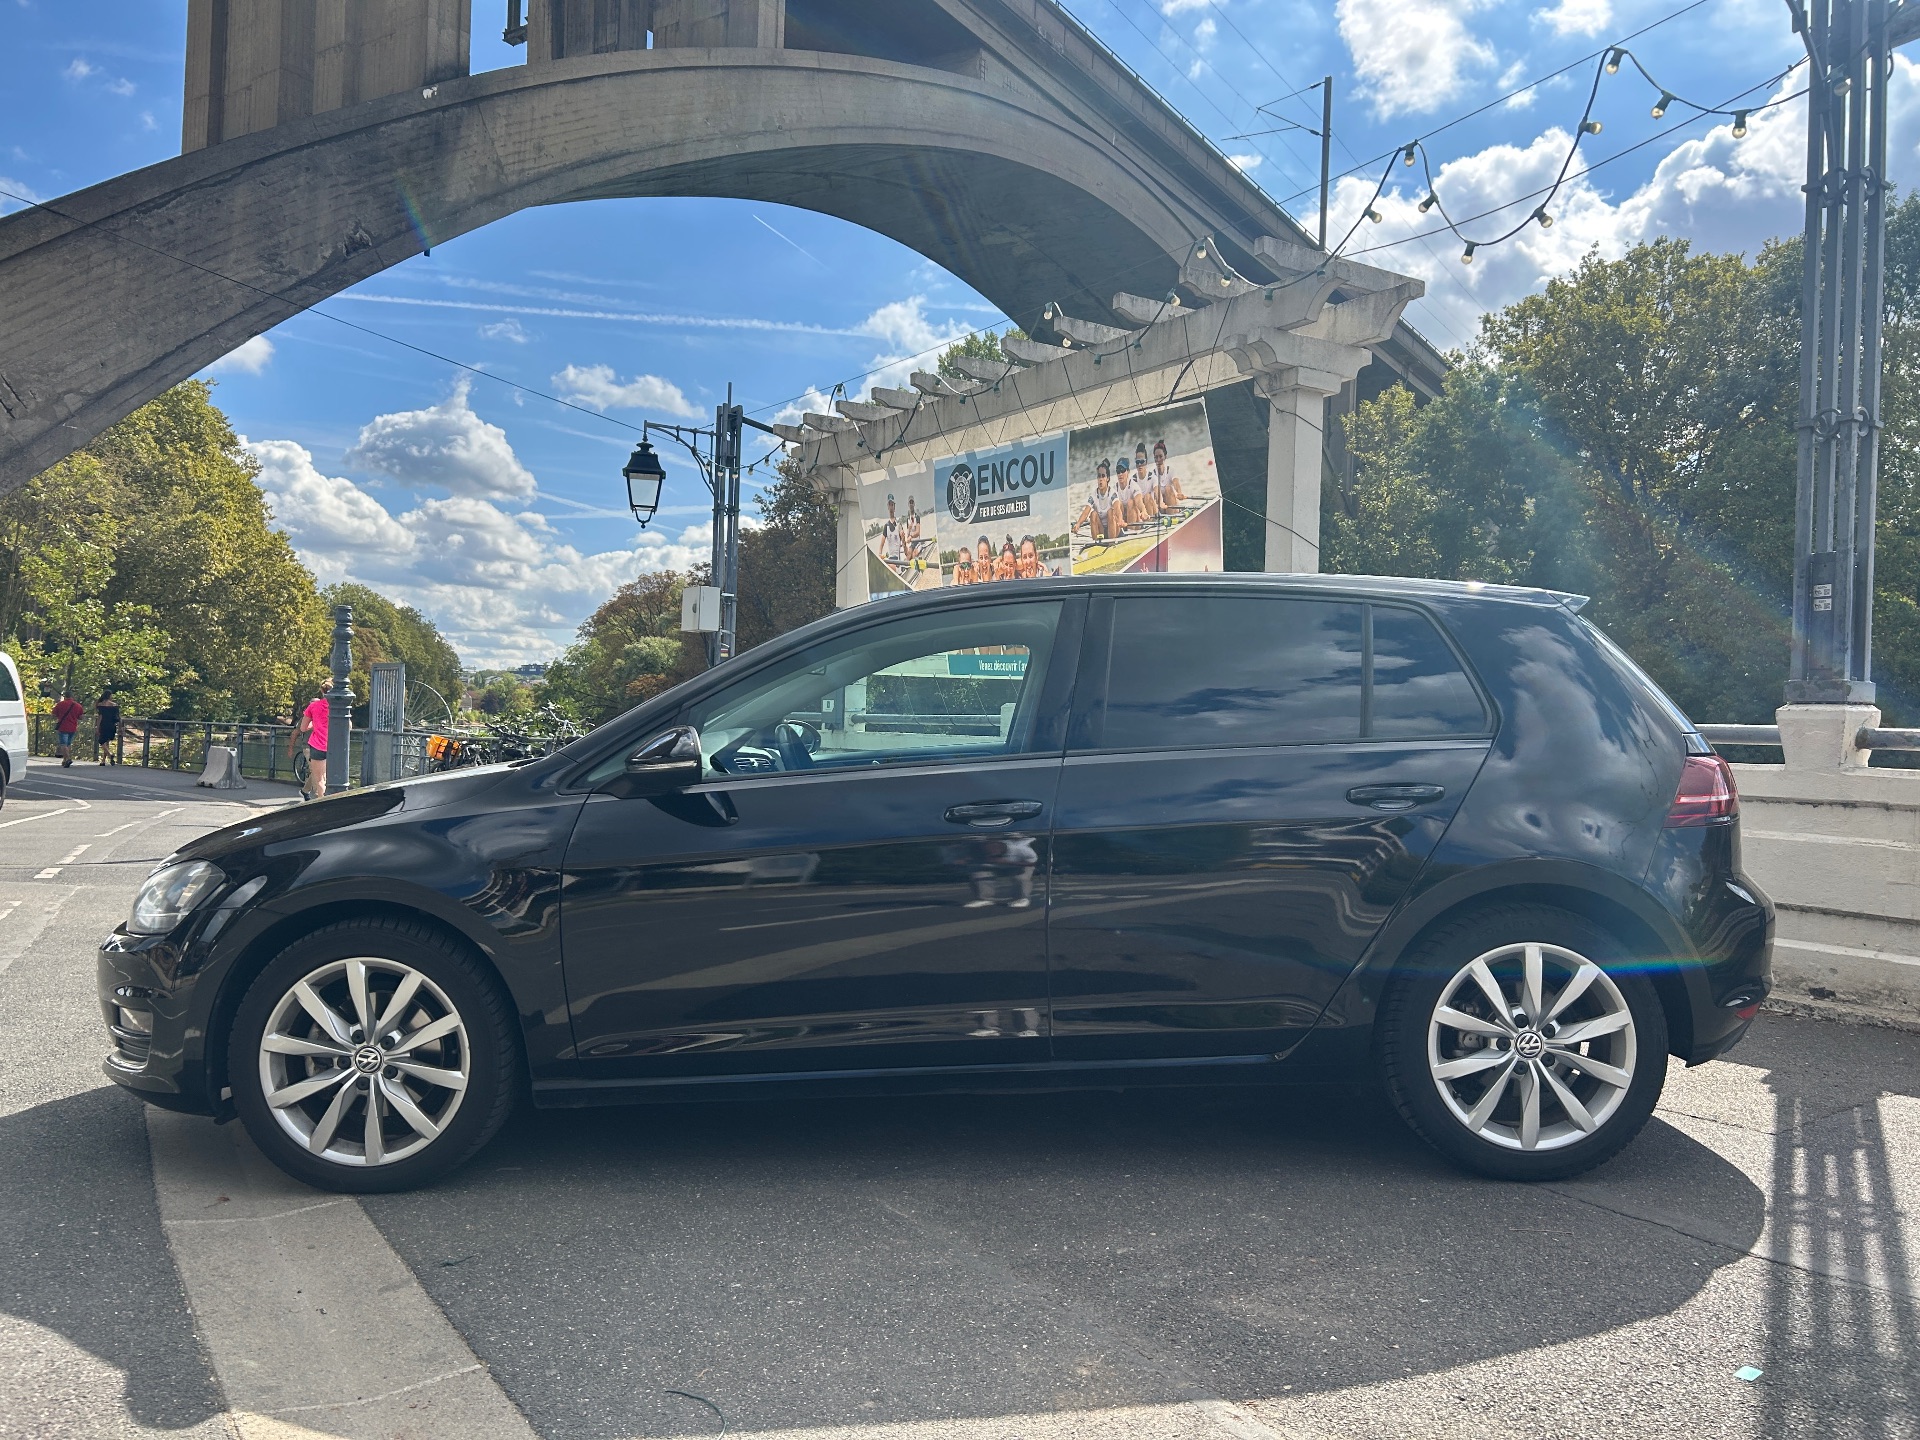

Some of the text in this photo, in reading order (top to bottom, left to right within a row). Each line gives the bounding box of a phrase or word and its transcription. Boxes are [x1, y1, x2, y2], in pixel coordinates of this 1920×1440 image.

[977, 450, 1054, 496] ENCOU
[979, 506, 990, 518] FIER
[990, 505, 997, 517] DE
[996, 504, 1006, 516] SES
[978, 659, 993, 671] Venez
[993, 659, 1017, 671] découvrir
